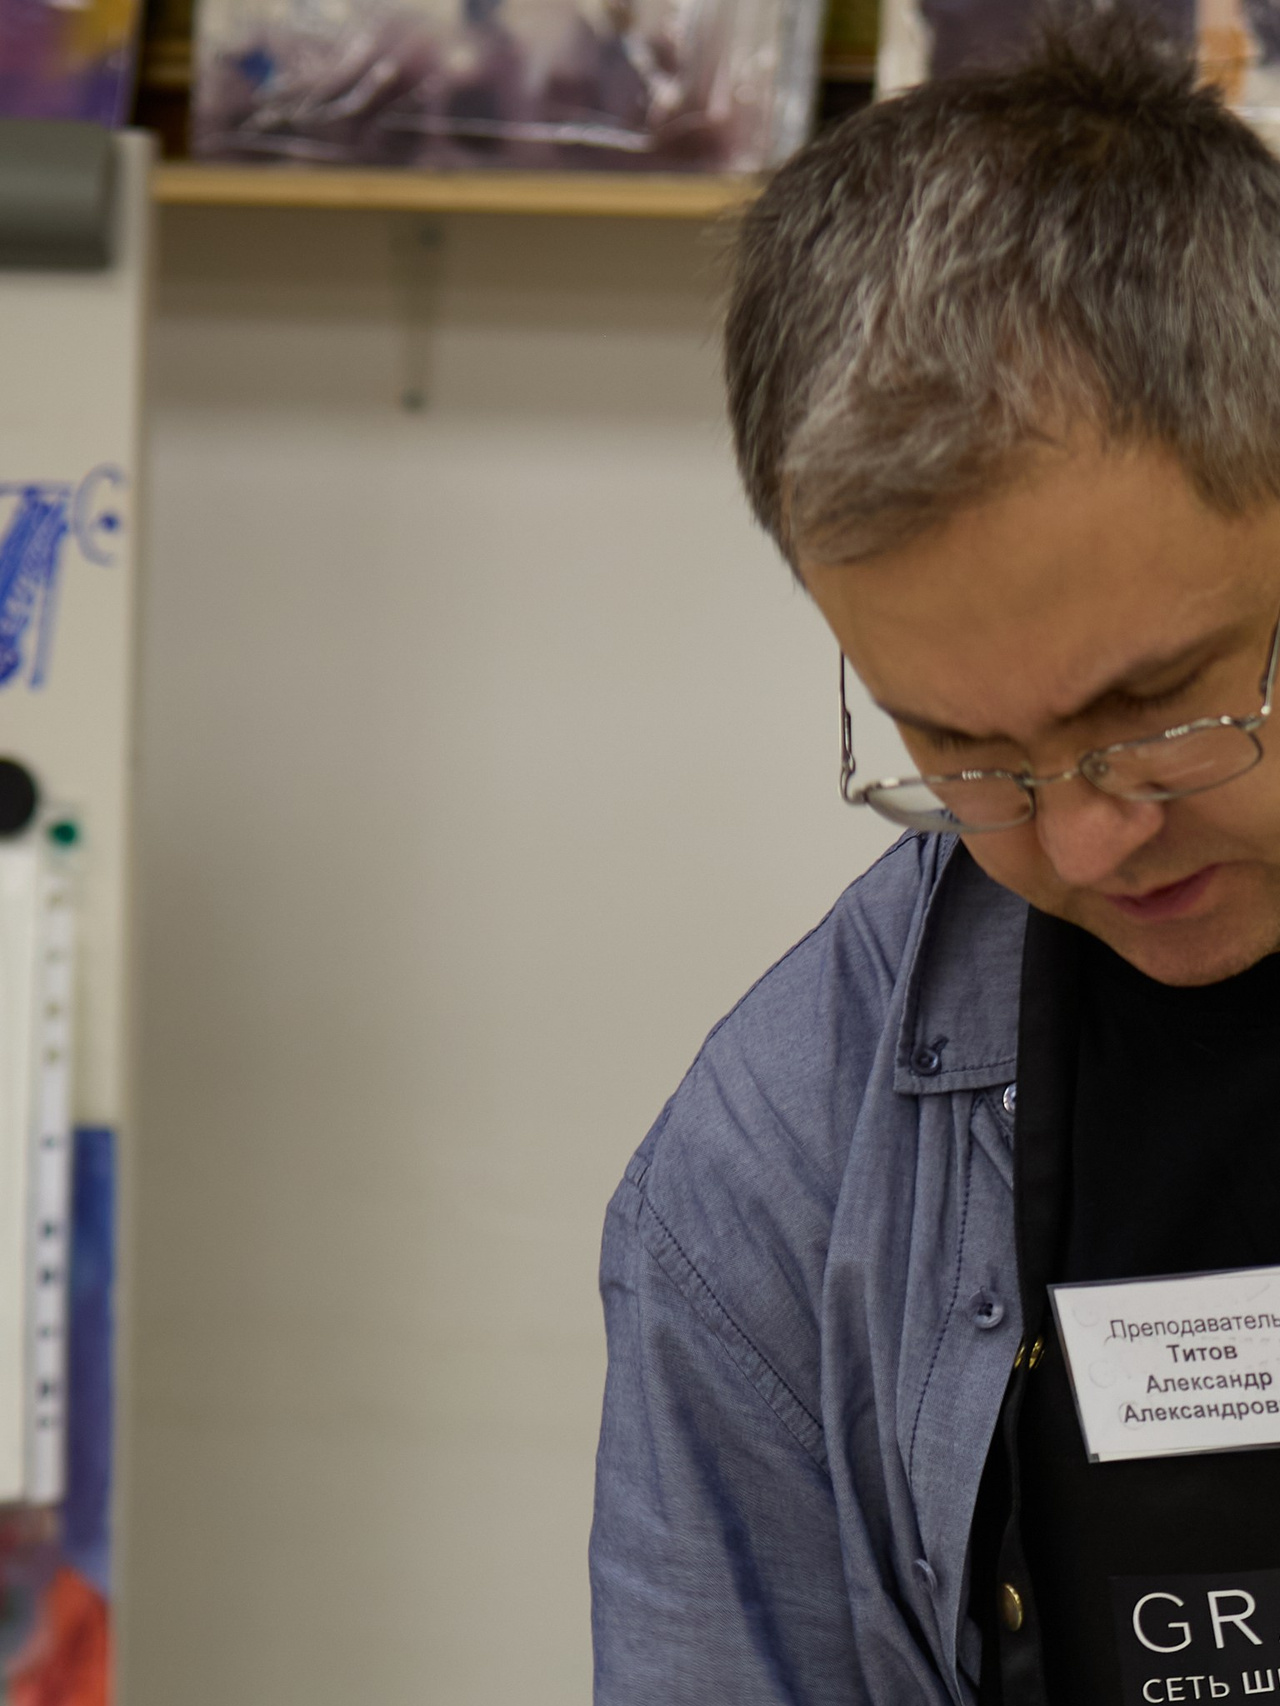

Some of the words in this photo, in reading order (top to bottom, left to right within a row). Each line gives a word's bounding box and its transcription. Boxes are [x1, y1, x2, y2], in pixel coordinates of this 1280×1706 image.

[1165, 1342, 1238, 1364] Титов
[1146, 1369, 1273, 1394] Александр
[1142, 1675, 1230, 1704] СЕТЬ
